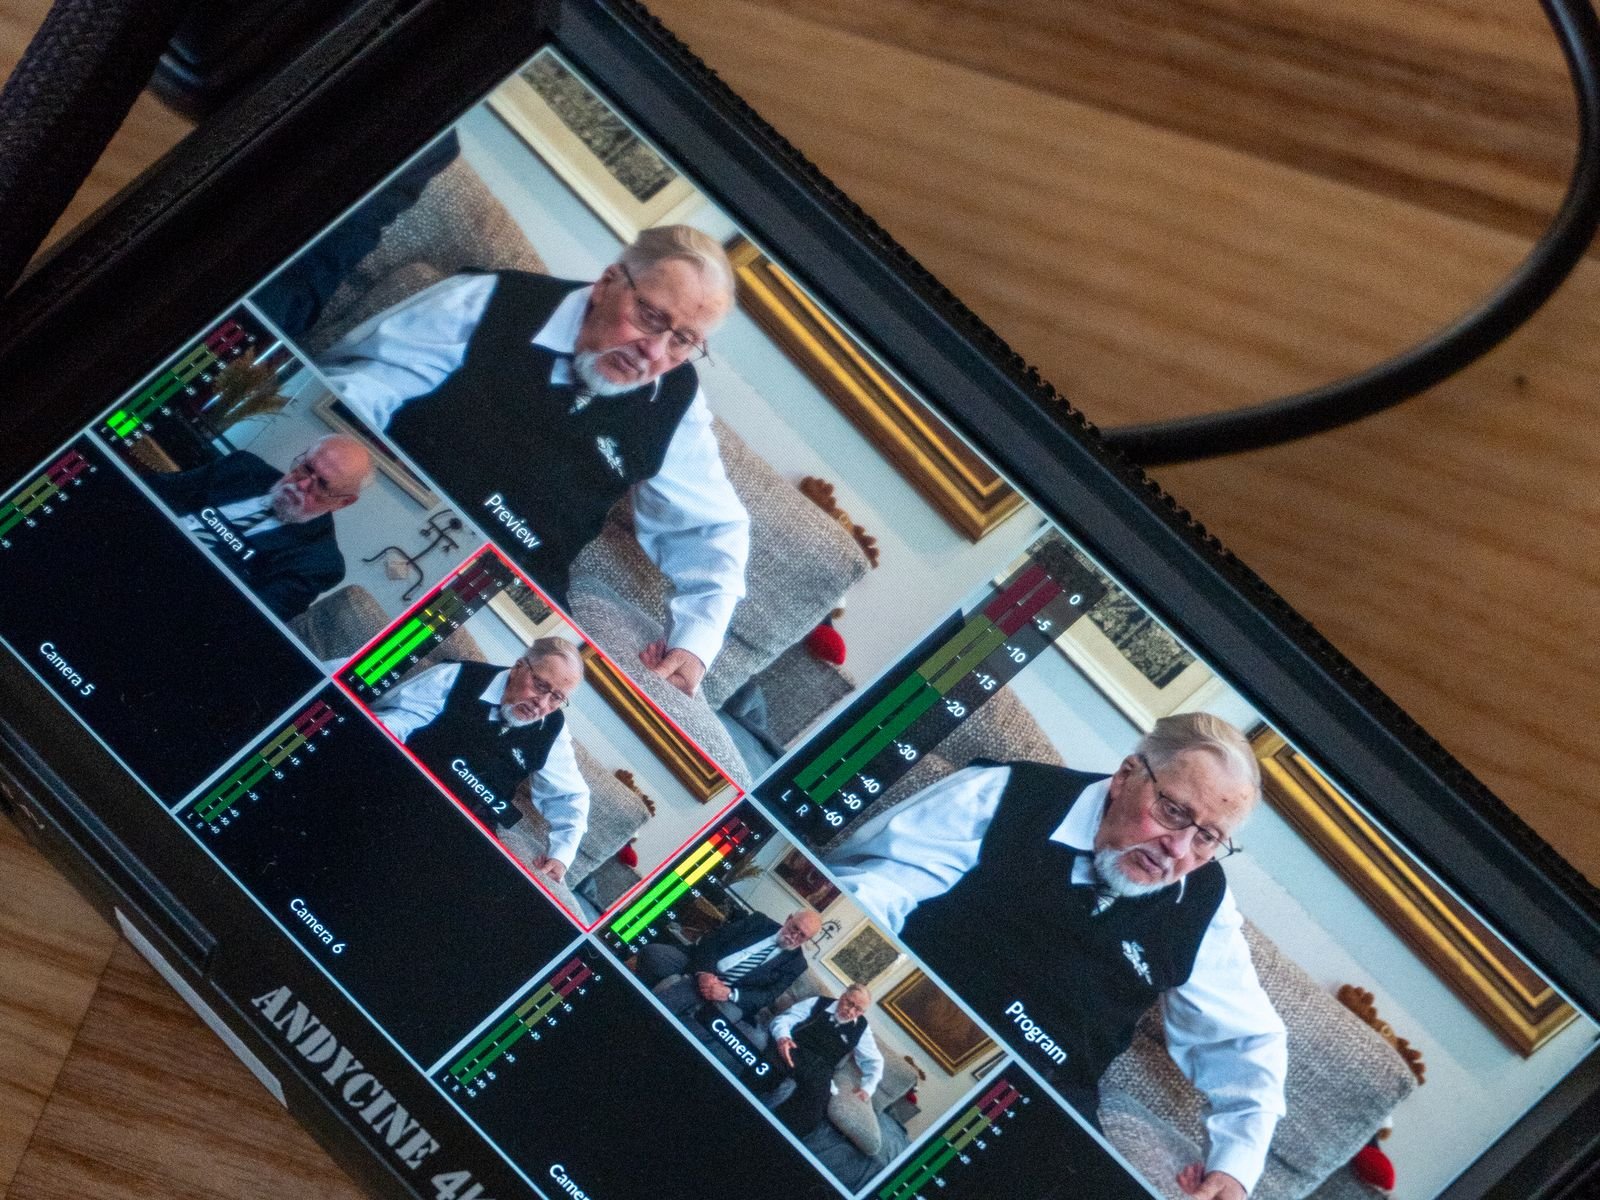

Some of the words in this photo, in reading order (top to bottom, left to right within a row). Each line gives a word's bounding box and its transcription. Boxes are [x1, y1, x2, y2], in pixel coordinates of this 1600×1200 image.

[484, 494, 540, 549] Preview
[201, 508, 243, 551] Camera
[243, 549, 254, 560] 1
[1069, 594, 1081, 605] 0
[1036, 619, 1051, 631] -5
[1007, 645, 1026, 663] -10
[40, 642, 82, 686] Camera
[80, 683, 95, 696] 5
[976, 673, 996, 690] -15
[946, 699, 965, 717] -20
[897, 743, 917, 761] -30
[451, 759, 494, 804] Camera
[492, 801, 507, 814] 2
[860, 776, 880, 793] -40
[781, 789, 791, 802] L
[796, 803, 809, 817] R
[842, 792, 861, 810] -50
[823, 809, 843, 826] -60
[290, 898, 333, 944] Camera
[332, 943, 346, 954] 6
[1005, 1001, 1067, 1065] Program
[711, 1018, 757, 1066] Camera
[755, 1062, 769, 1075] 3
[251, 985, 441, 1171] ANDYCINE
